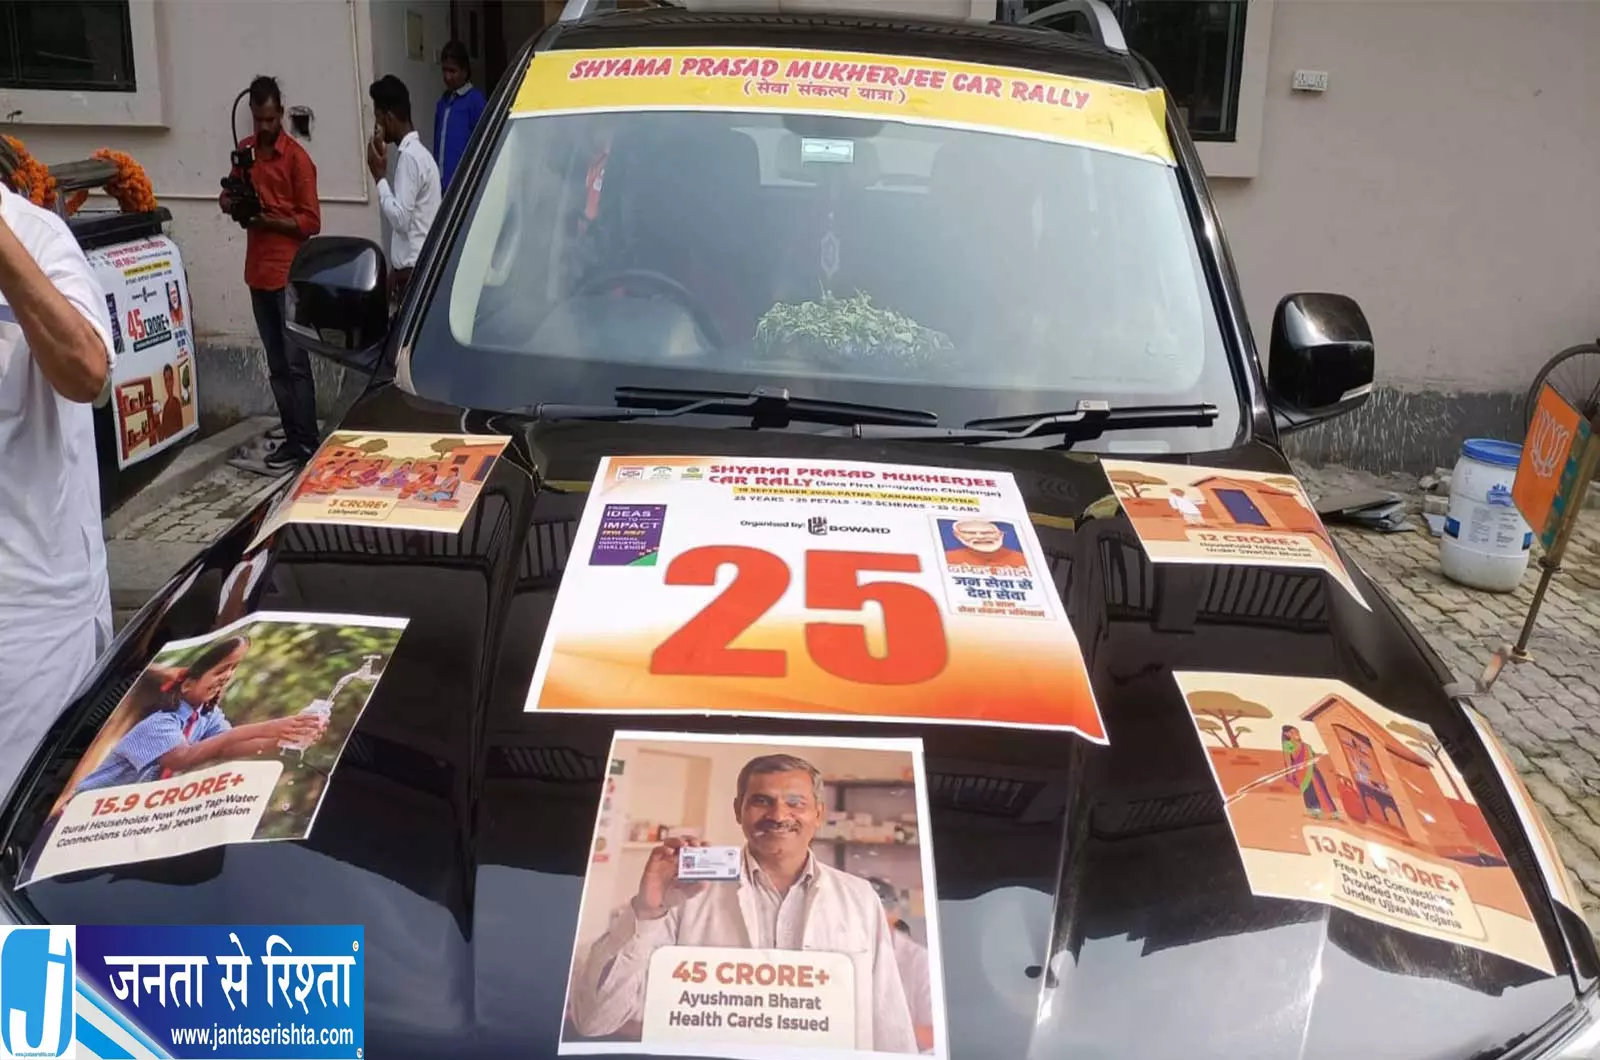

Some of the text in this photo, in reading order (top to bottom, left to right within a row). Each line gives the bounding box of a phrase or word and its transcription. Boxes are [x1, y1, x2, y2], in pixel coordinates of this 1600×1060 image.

[569, 57, 1090, 109] SHYAMA PRASAD MUKHERJEE CAR RALLY
[797, 80, 850, 97] संकल्प
[128, 307, 146, 340] 45
[708, 476, 748, 486] CAR
[755, 477, 813, 488] RALLY
[709, 465, 790, 476] SHYAMA
[796, 467, 876, 479] PRASAD
[881, 472, 997, 488] MUKHERJEE
[340, 499, 389, 510] CRORE+
[829, 525, 891, 535] BOWARD
[1198, 534, 1300, 546] 12 CRORE+
[952, 575, 1034, 591] जन सेवा से
[964, 586, 1027, 601] देश सेवा
[650, 544, 949, 686] 25
[92, 771, 245, 818] 15.9 CRORE+
[60, 793, 260, 836] Rural Households Now Have Tap-Water
[56, 806, 251, 849] Connections Under Jal Jeevan Mission
[1332, 858, 1361, 877] Free
[1360, 869, 1383, 885] LPG
[1342, 872, 1391, 898] Provided
[1392, 891, 1407, 904] to
[1341, 884, 1463, 930] Under Ujjwala Yojana
[672, 960, 830, 988] 45 CRORE+
[678, 990, 822, 1010] Ayushman Bharat
[669, 1011, 830, 1032] Health Cards Issued
